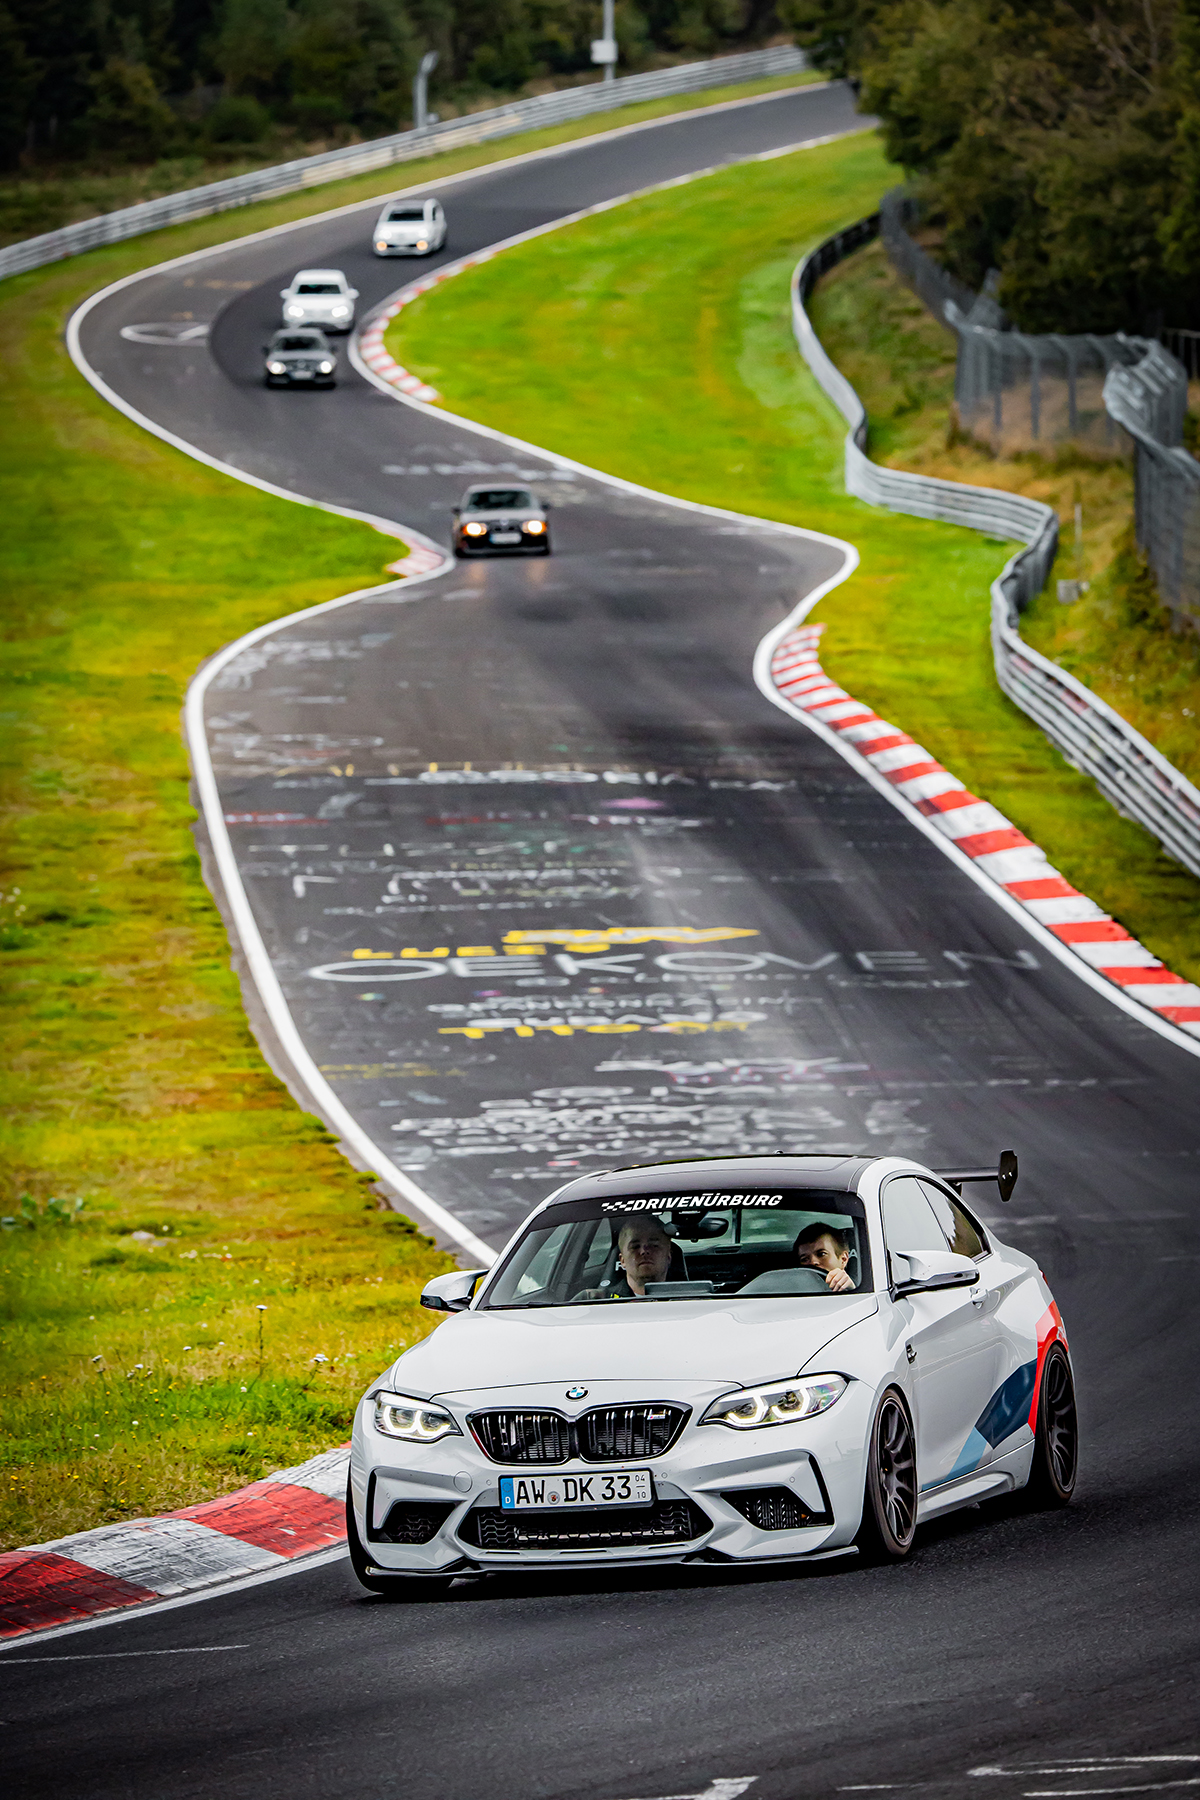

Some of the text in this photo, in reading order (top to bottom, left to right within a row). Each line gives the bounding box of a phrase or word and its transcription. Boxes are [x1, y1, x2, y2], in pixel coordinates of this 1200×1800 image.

[307, 950, 1043, 982] OEKOVEN
[632, 1193, 783, 1211] DRIVENÜRBURG
[635, 1474, 646, 1482] 04
[516, 1475, 632, 1504] AW DK 33
[636, 1491, 647, 1499] 10
